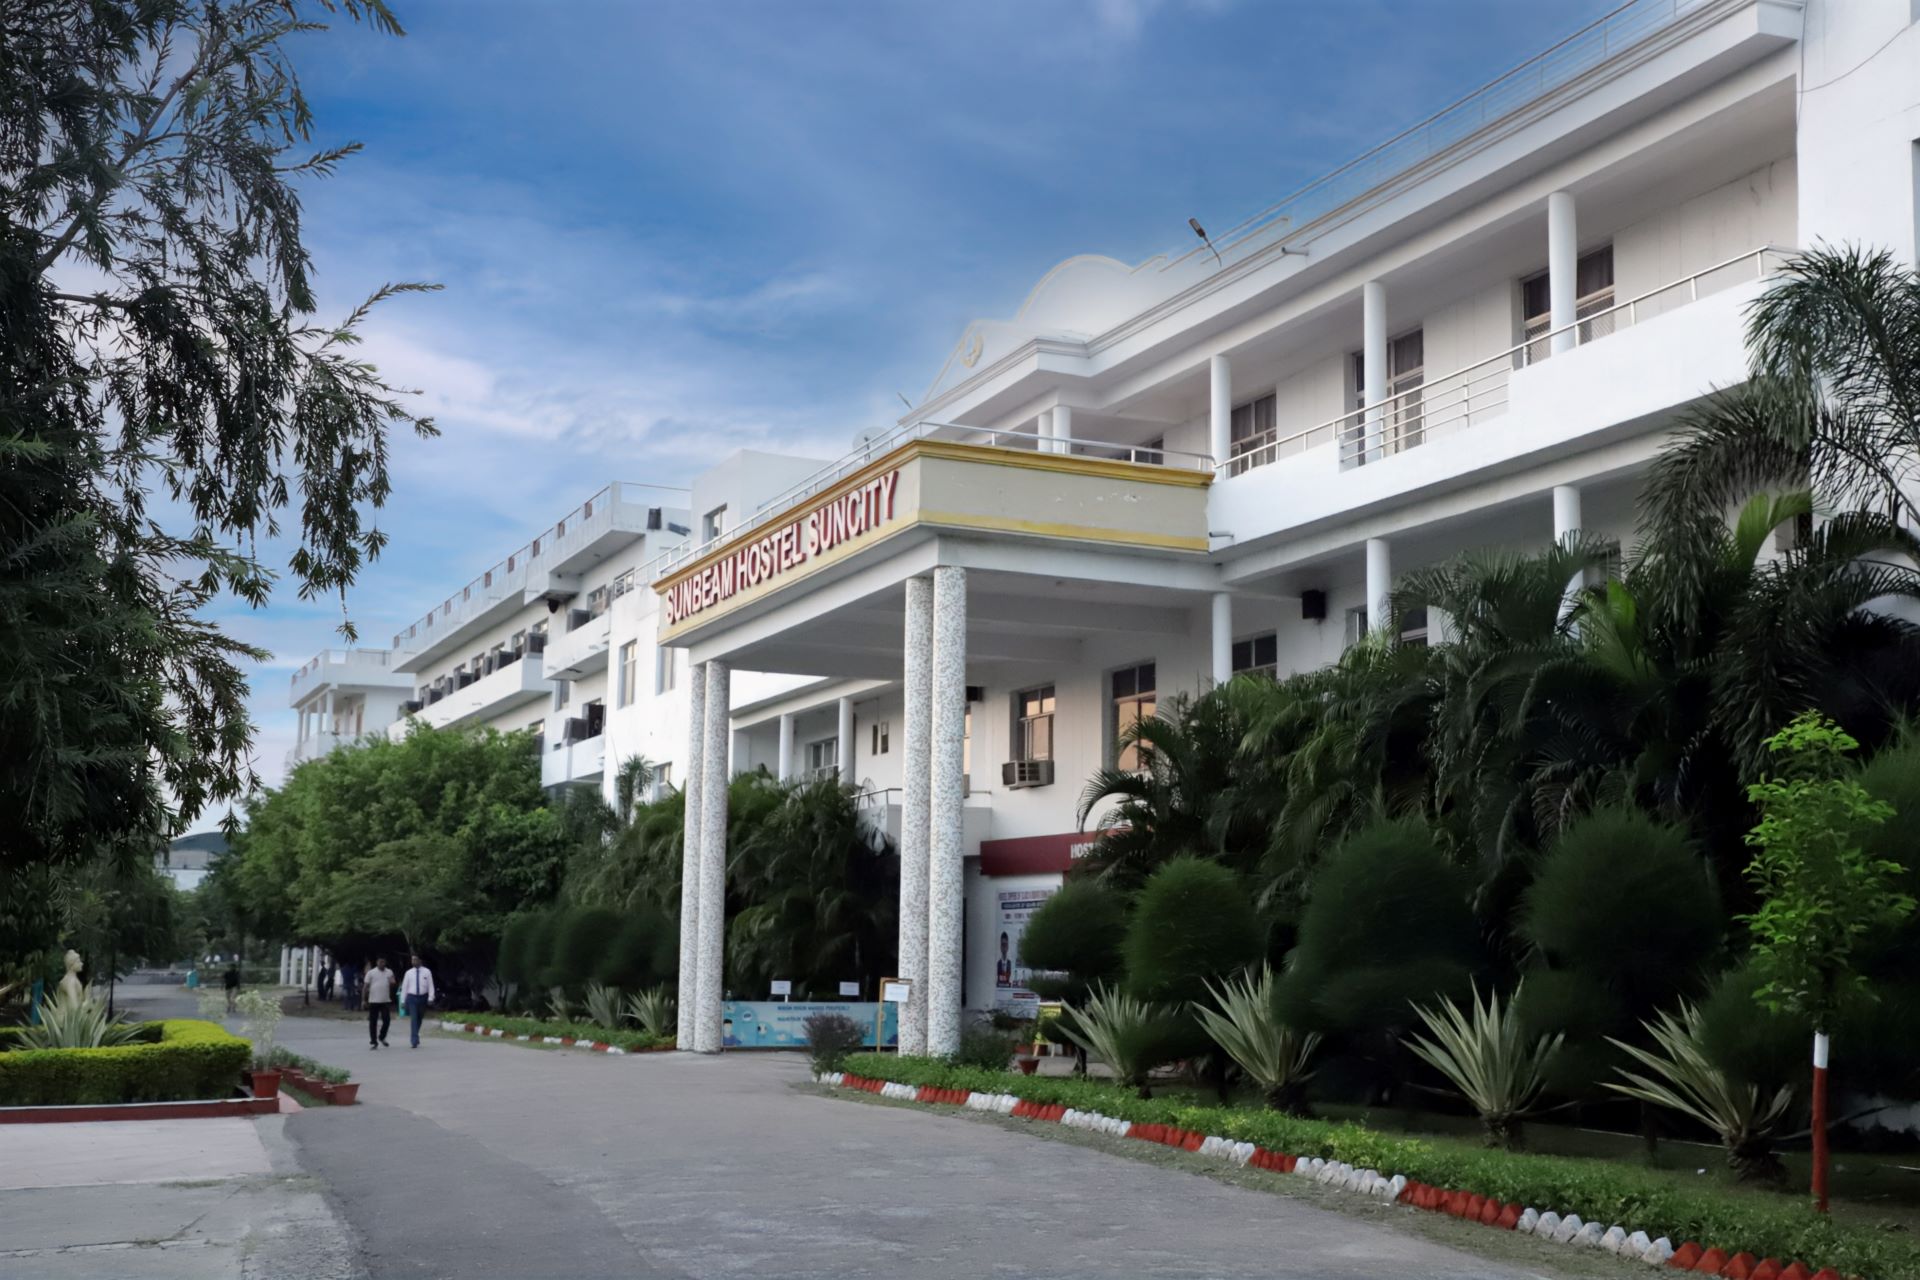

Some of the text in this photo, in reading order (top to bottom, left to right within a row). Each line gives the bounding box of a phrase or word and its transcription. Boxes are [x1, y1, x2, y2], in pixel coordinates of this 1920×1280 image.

[666, 470, 899, 625] SUNBEAM HOSTEL SUNCITY
